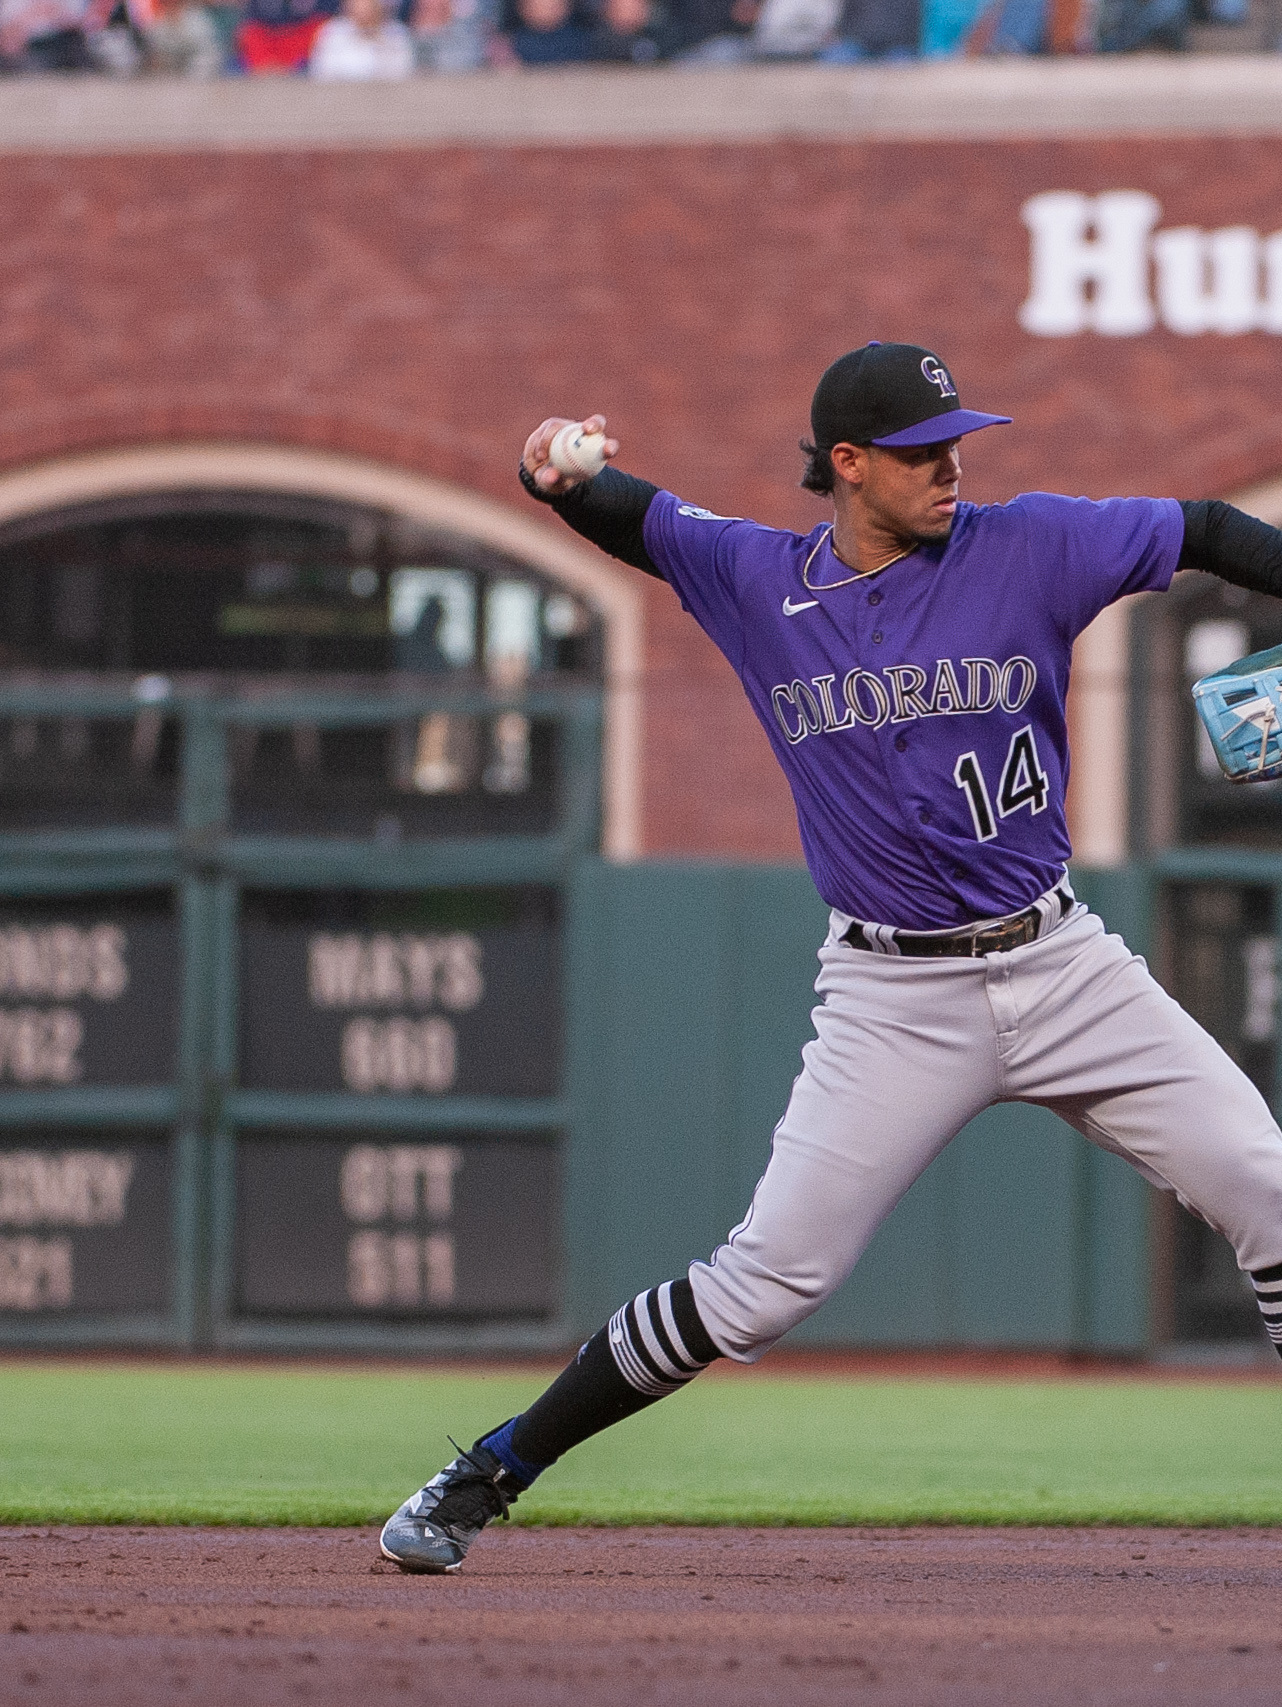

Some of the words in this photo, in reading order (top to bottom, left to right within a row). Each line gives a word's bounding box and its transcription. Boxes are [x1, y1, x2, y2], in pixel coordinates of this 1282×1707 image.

[771, 655, 1037, 745] COLORADO
[953, 723, 1050, 843] 14
[307, 930, 484, 1010] MAYS
